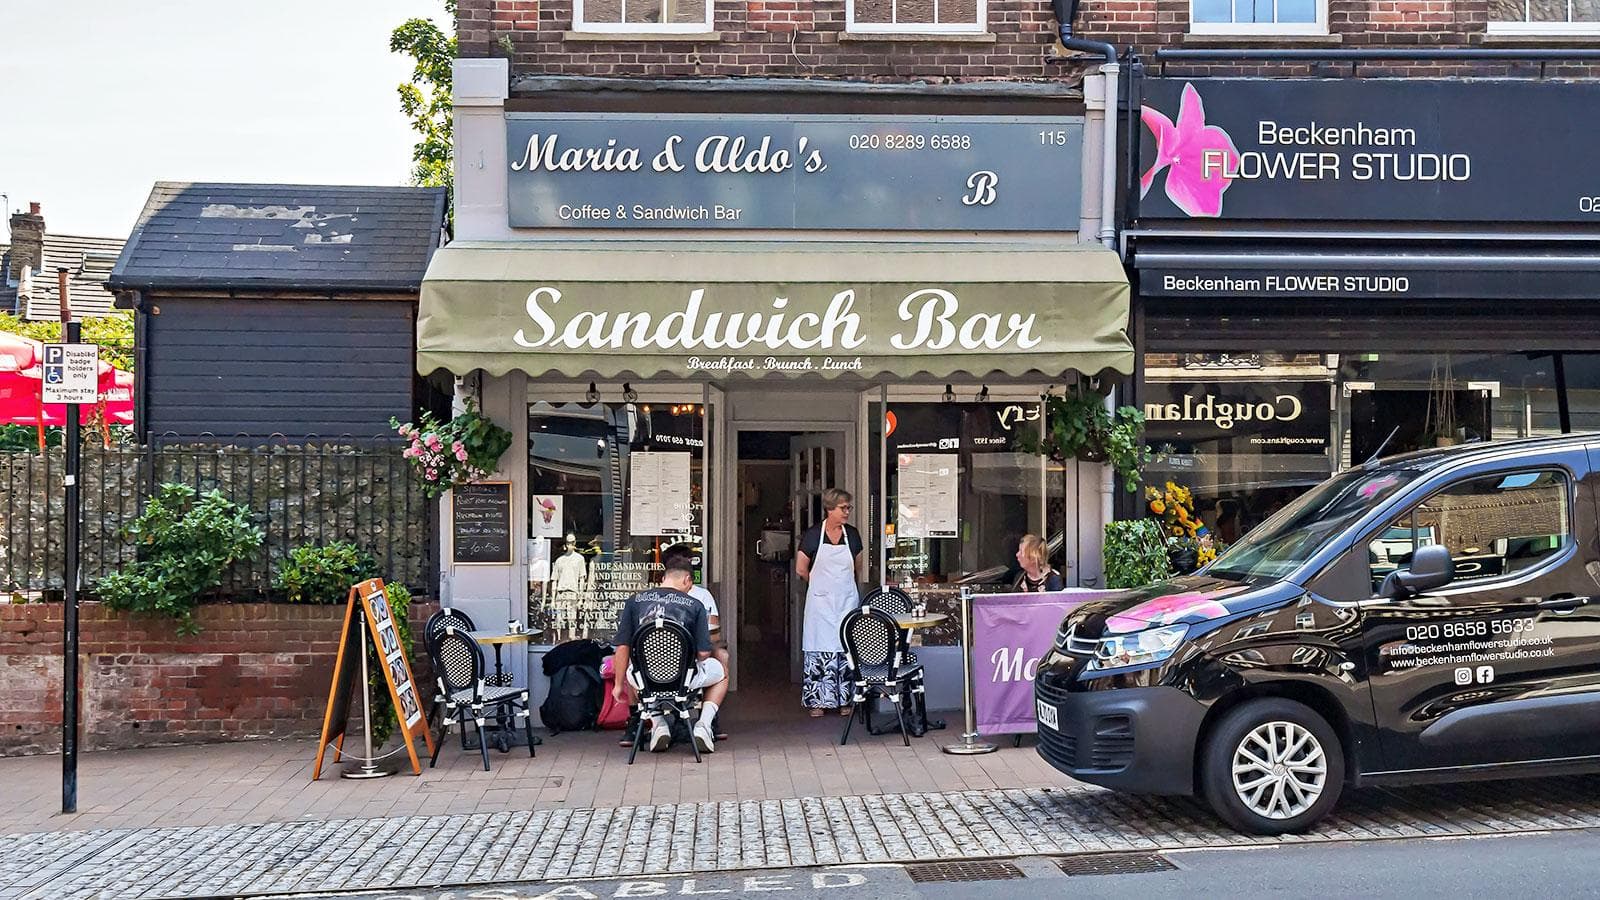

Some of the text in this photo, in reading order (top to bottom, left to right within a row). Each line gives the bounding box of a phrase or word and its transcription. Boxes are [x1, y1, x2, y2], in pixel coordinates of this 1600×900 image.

[849, 134, 971, 149] 020 8289 6588
[1039, 131, 1066, 145] 115
[1258, 120, 1416, 146] Beckenham
[511, 134, 828, 173] Maria & Aldo's
[1204, 151, 1471, 181] FLOWER STUDIO
[962, 170, 999, 205] B
[558, 205, 742, 220] Coffee & Sandwich Bar
[1163, 276, 1409, 292] Beckenham FLOWER STUDIO
[513, 287, 1042, 351] Sandwich Bar
[50, 348, 62, 362] P
[686, 356, 862, 373] Breakfast Brunch Lunch
[613, 563, 666, 571] SANDWICHES
[1406, 618, 1534, 640] 020 8658 5633
[1390, 635, 1553, 656] info@beckenhamflowerstudio.co.uk
[1391, 648, 1555, 668] www.beckenhamflowerstudio.co.uk
